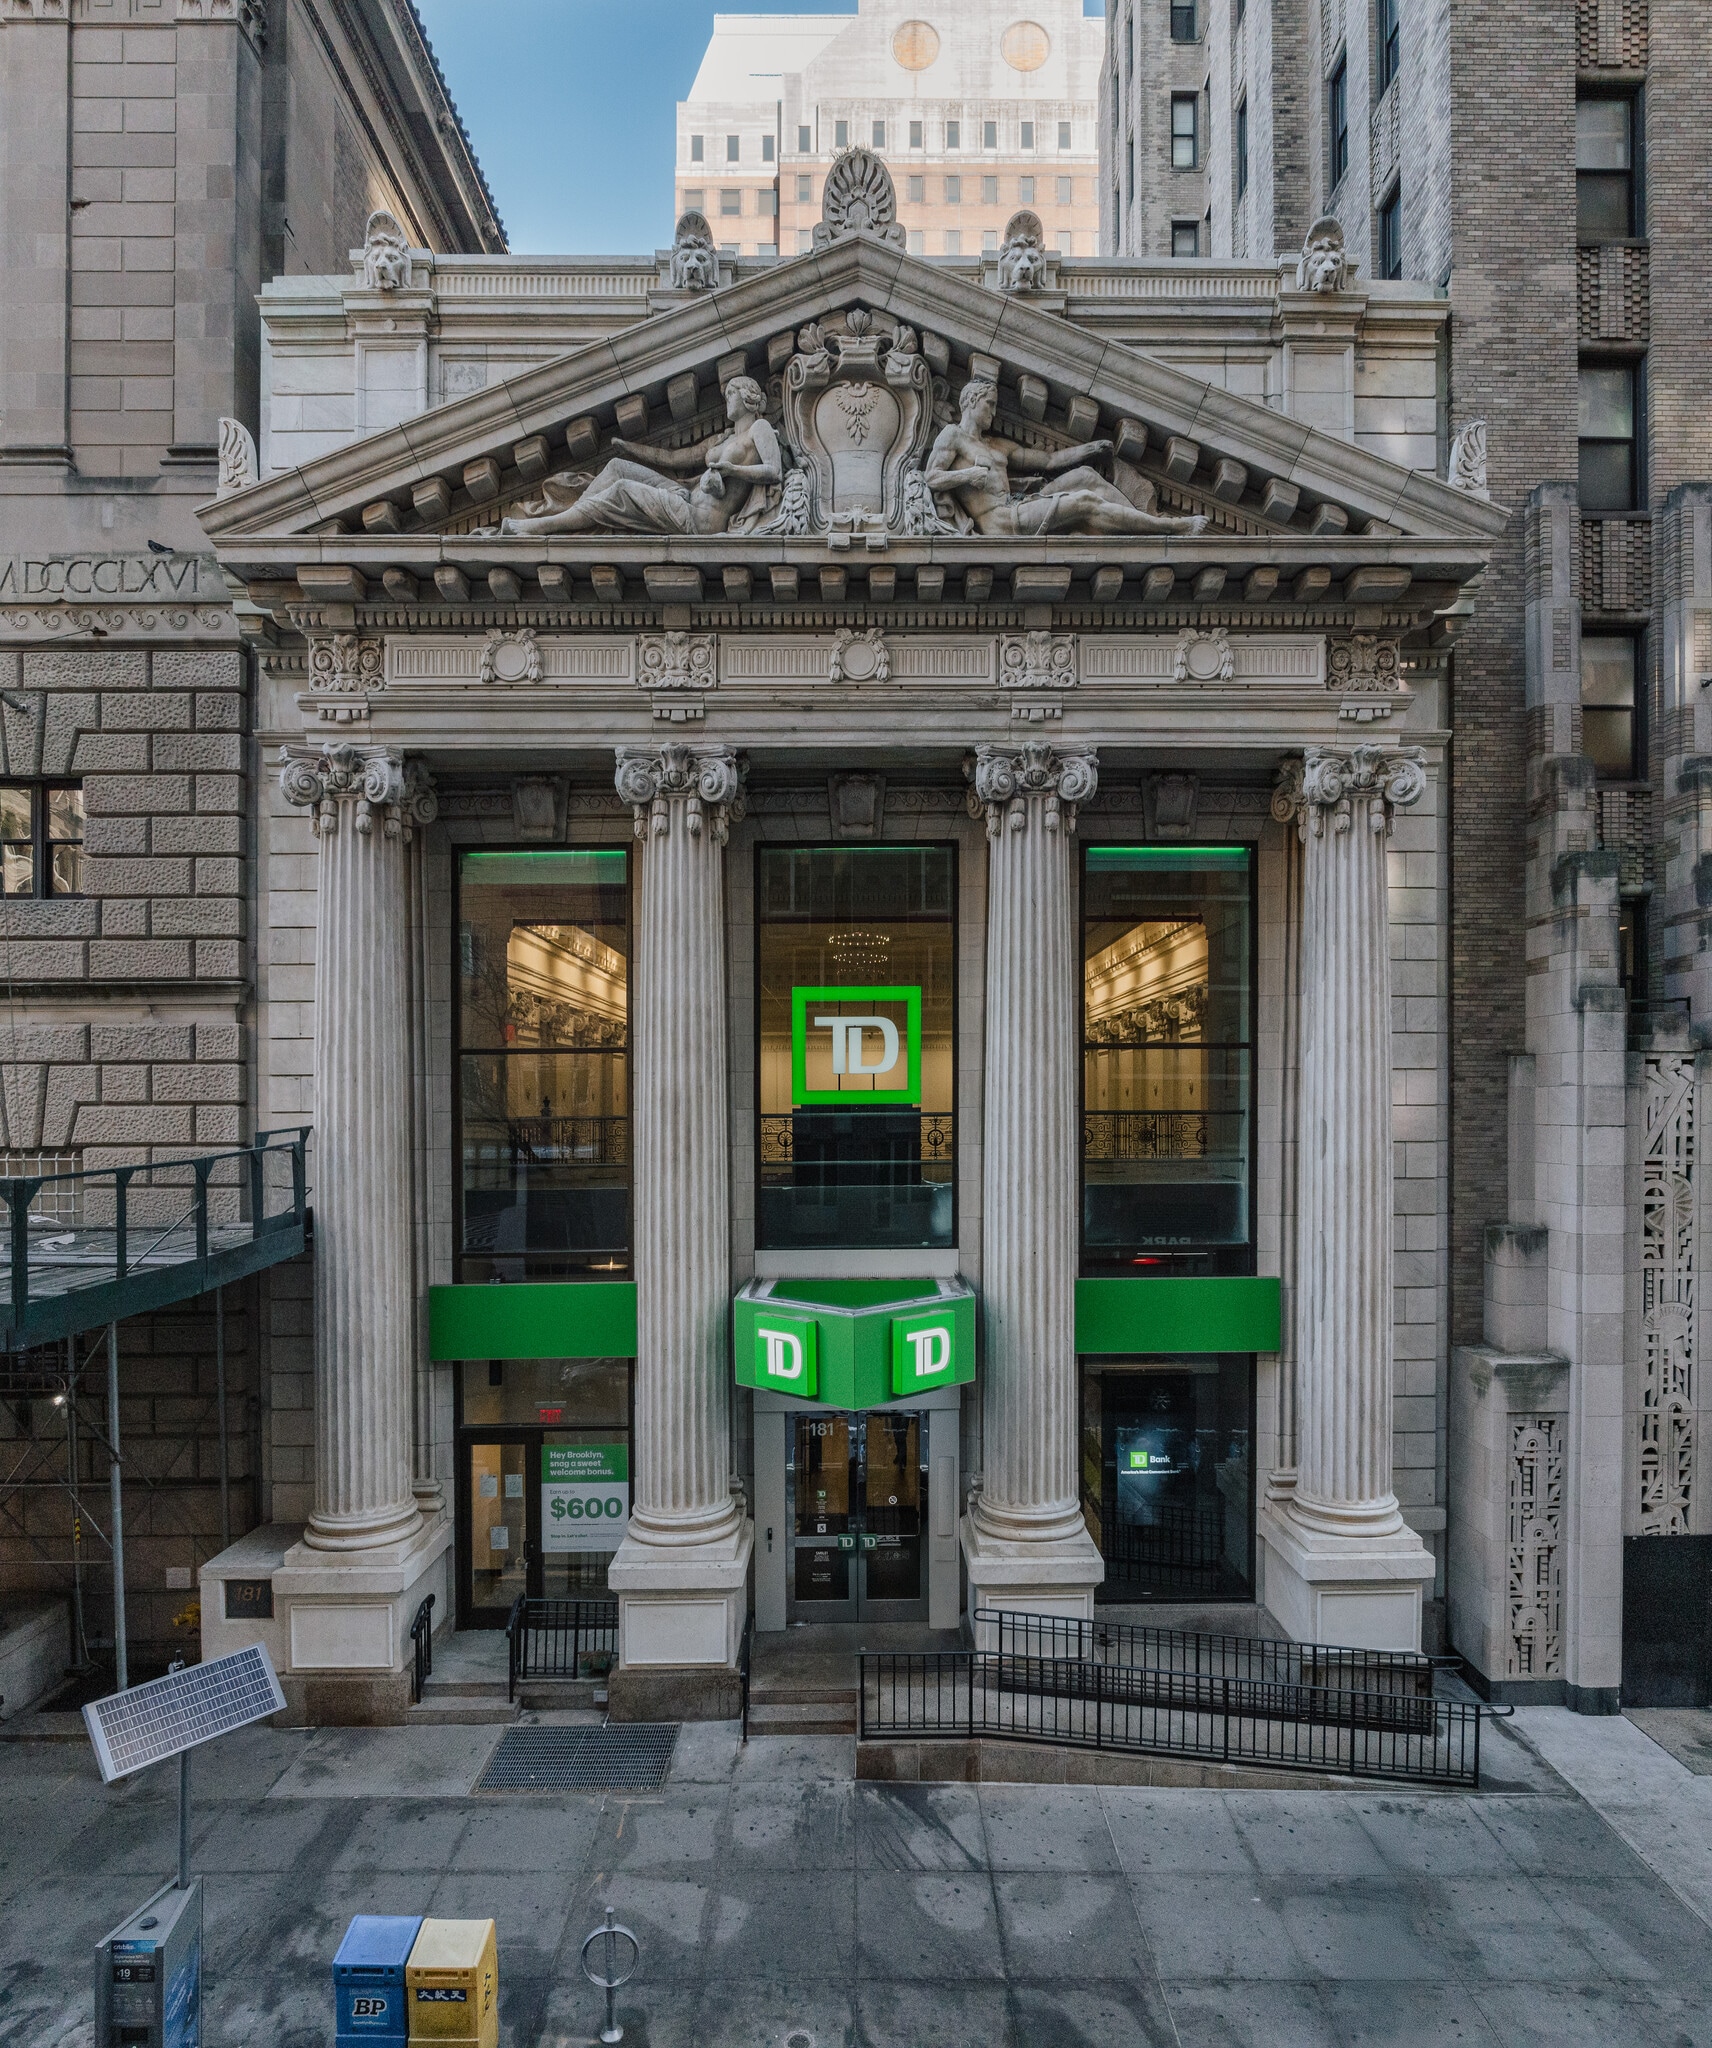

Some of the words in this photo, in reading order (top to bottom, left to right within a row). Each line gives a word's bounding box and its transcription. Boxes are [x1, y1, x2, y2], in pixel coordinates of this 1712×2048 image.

[814, 1016, 900, 1075] TD
[757, 1328, 803, 1379] TD
[906, 1326, 951, 1376] TD
[810, 1422, 834, 1437] 181
[550, 1451, 566, 1460] Hey
[567, 1450, 604, 1460] Brooklyn,
[1132, 1454, 1146, 1465] TD
[1150, 1455, 1170, 1463] Bank
[550, 1496, 623, 1521] $600
[840, 1537, 854, 1548] TD
[862, 1537, 876, 1548] TD
[235, 1585, 262, 1602] 181
[353, 1998, 386, 2016] BP
